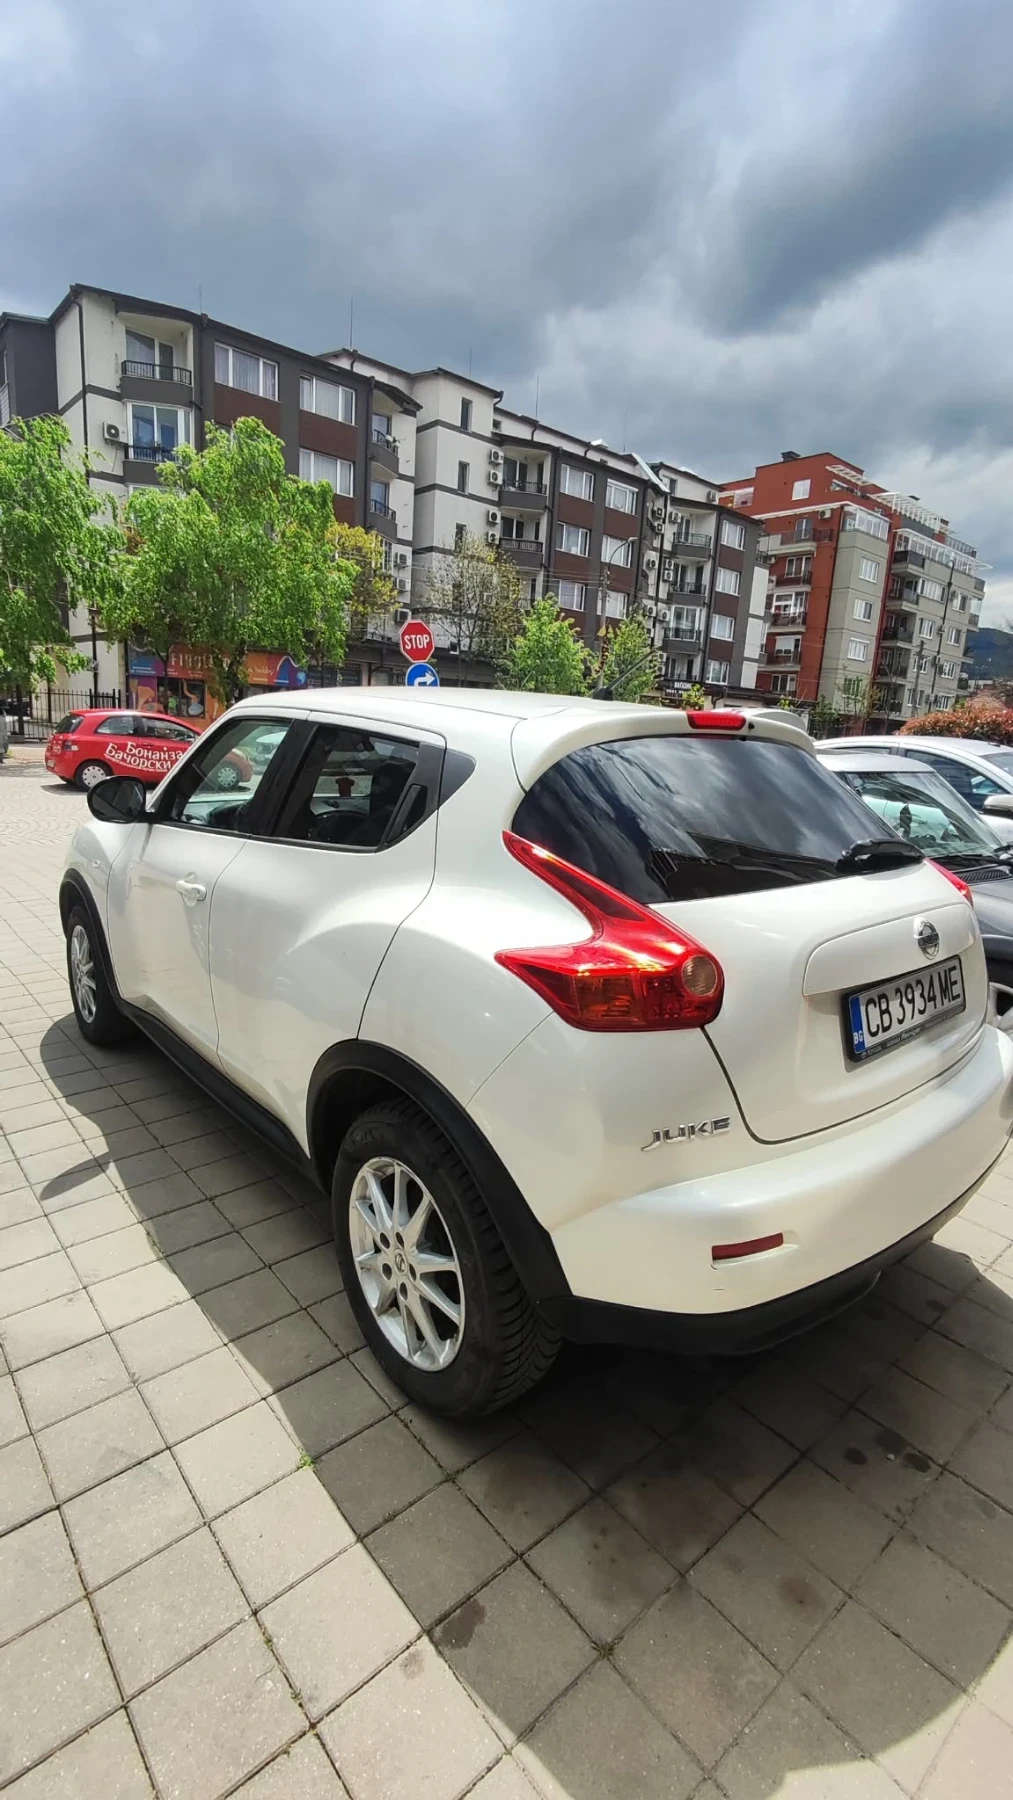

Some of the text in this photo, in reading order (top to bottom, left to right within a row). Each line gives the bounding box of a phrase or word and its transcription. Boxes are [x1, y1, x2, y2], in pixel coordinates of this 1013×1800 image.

[404, 634, 430, 649] STOP
[105, 742, 172, 771] Бачорски
[865, 993, 893, 1038] CB
[895, 974, 938, 1025] 3934
[938, 965, 961, 1007] ME
[853, 1030, 864, 1045] BG
[641, 1115, 731, 1152] JUKE
